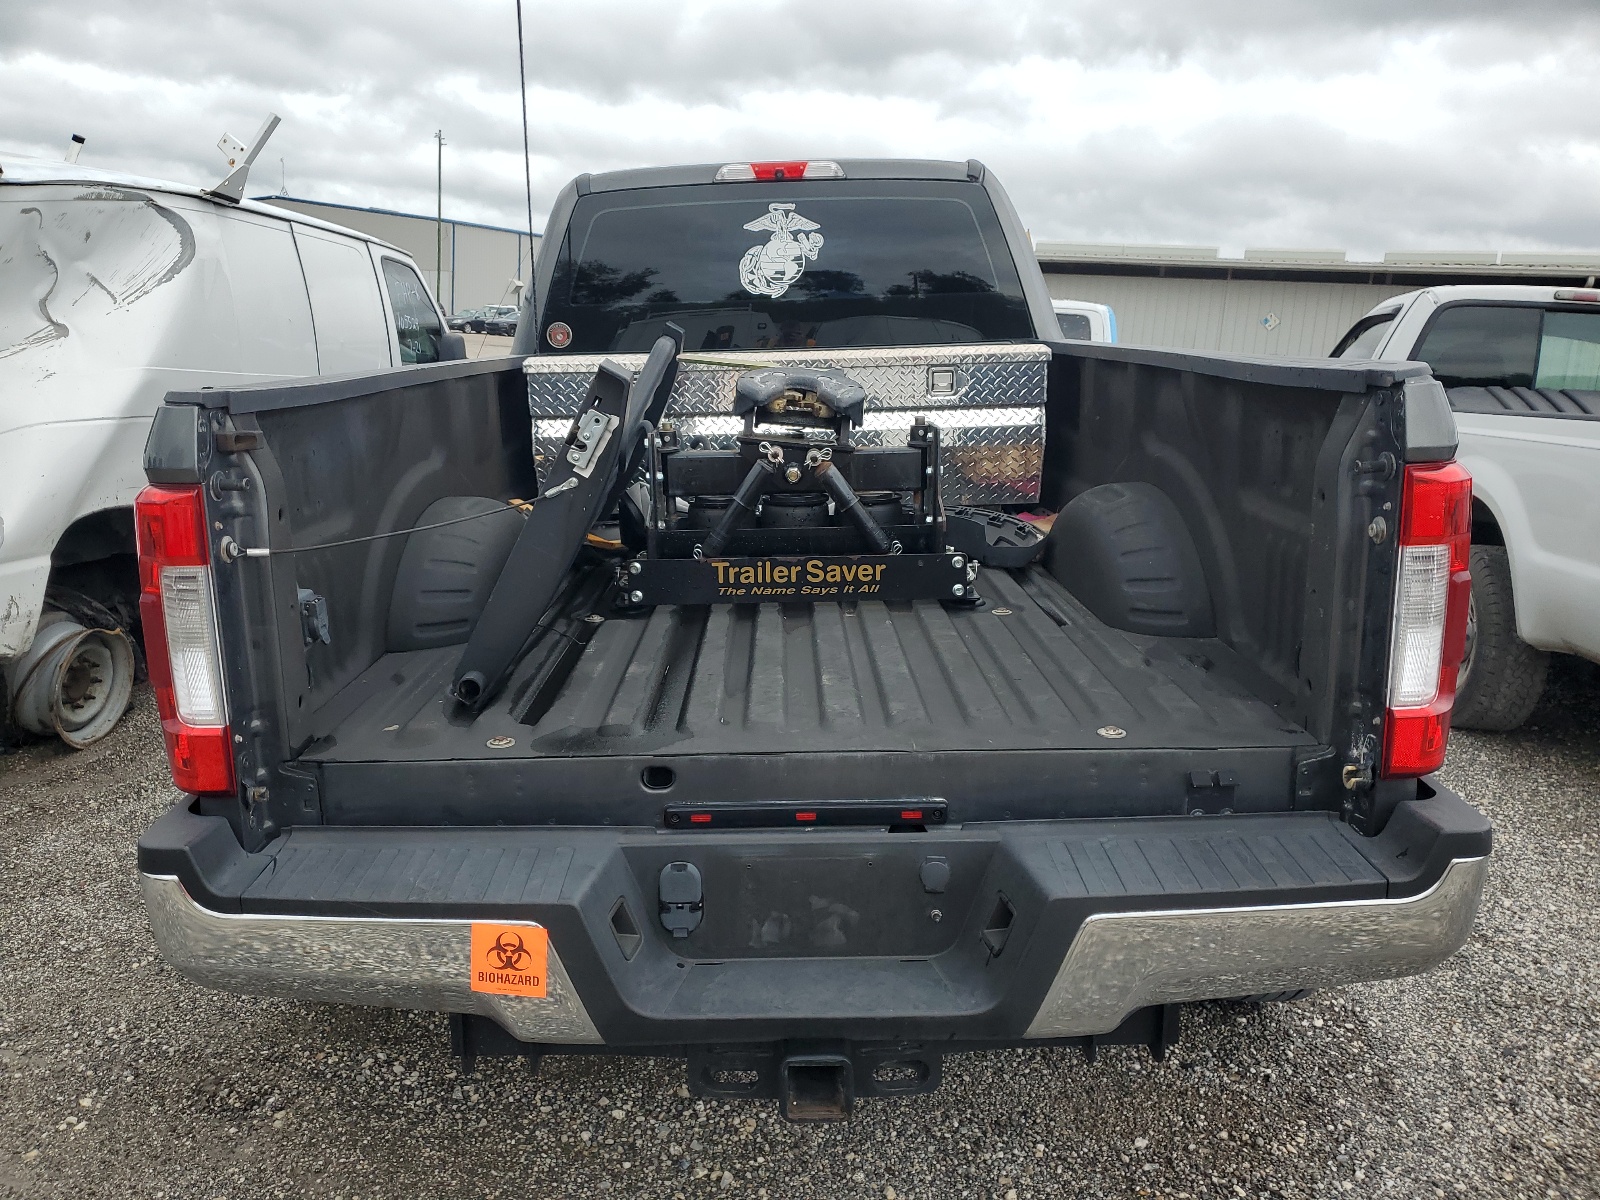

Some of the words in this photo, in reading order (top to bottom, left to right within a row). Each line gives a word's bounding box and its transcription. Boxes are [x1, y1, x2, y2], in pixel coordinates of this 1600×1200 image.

[711, 561, 802, 584] Trailer
[806, 559, 887, 583] Saver
[718, 586, 747, 596] The
[750, 586, 796, 595] Name
[800, 585, 839, 596] Says
[843, 585, 856, 594] It
[857, 584, 880, 593] All
[478, 971, 540, 987] BIOHAZARD
